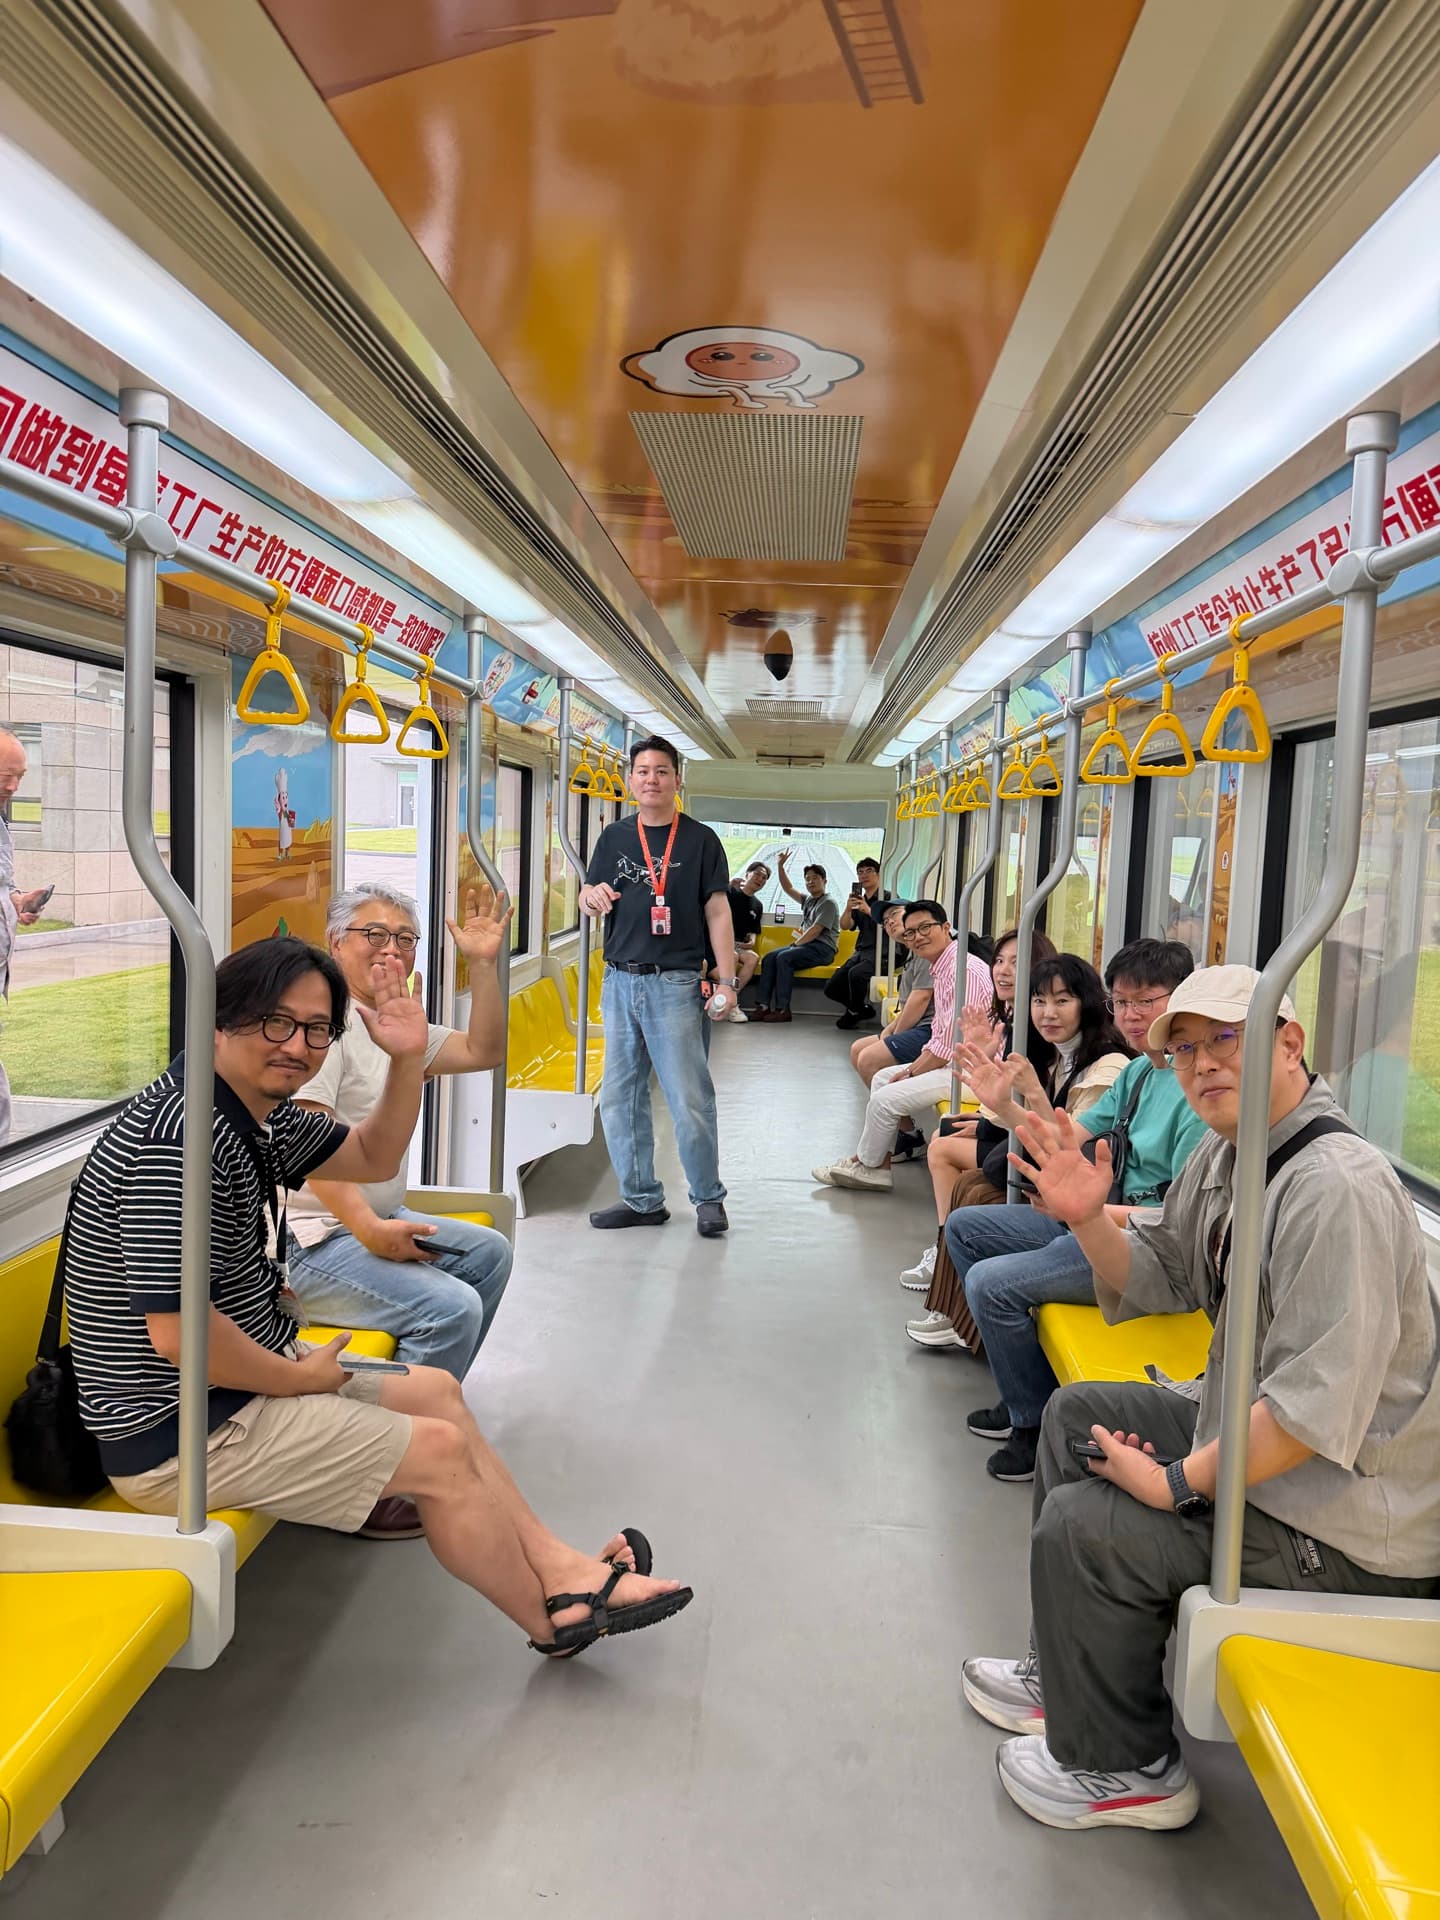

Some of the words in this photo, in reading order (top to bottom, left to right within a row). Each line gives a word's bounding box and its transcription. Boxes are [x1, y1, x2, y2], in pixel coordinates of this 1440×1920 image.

[0, 386, 446, 659] 做到每工厂生产的方便面口感都是一致的呢？
[1147, 464, 1440, 658] 杭州工厂迄今为止生产了多方便
